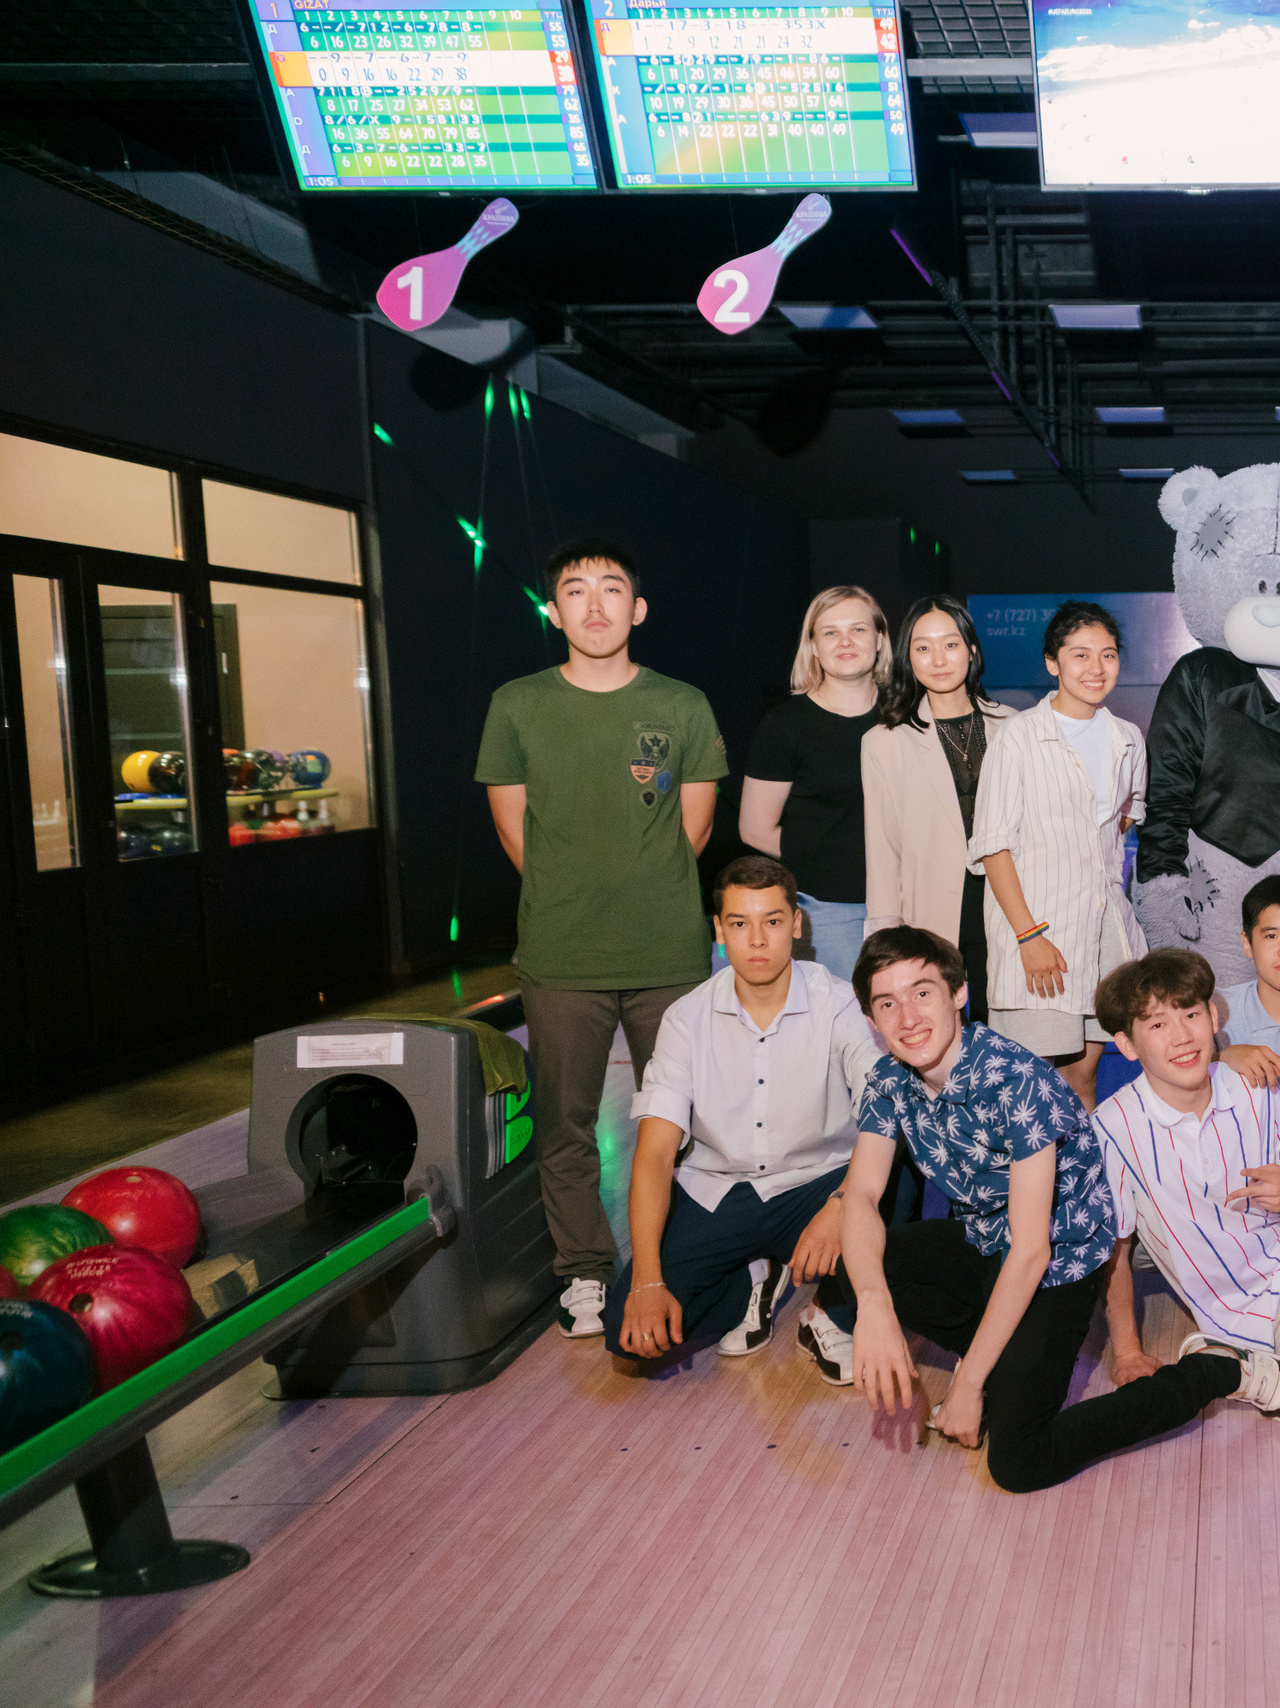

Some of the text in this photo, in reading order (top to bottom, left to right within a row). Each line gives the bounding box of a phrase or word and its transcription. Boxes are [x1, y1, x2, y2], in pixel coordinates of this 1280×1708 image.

[270, 2, 278, 18] 1
[294, 0, 330, 9] GIZAT
[604, 1, 614, 17] 2
[304, 10, 563, 21] 1 2 3 4 5 6 7 8 9 10 TTL
[842, 7, 854, 17] 10
[310, 35, 566, 48] 6 16 23 26 32 39 47 55 55
[319, 68, 467, 81] 0 9 16 16 22 29 38
[647, 67, 656, 80] 6
[669, 67, 679, 80] 11
[690, 67, 704, 80] 20
[712, 67, 727, 80] 29
[735, 67, 749, 80] 36
[884, 66, 899, 79] 60
[327, 98, 579, 112] 8 17 25 27 34 53 62 62
[650, 96, 663, 109] 10
[672, 96, 684, 109] 19
[694, 96, 709, 109] 29
[716, 96, 731, 109] 30
[332, 126, 584, 140] 16 36 55 64 70 79 85 85
[890, 123, 905, 135] 49
[342, 154, 590, 168] 6 9 16 22 22 28 35 35
[308, 177, 334, 186] 1:05
[626, 174, 651, 184] 1:05
[397, 266, 423, 321] 1
[713, 269, 750, 323] 2
[1005, 608, 1037, 623] (727)
